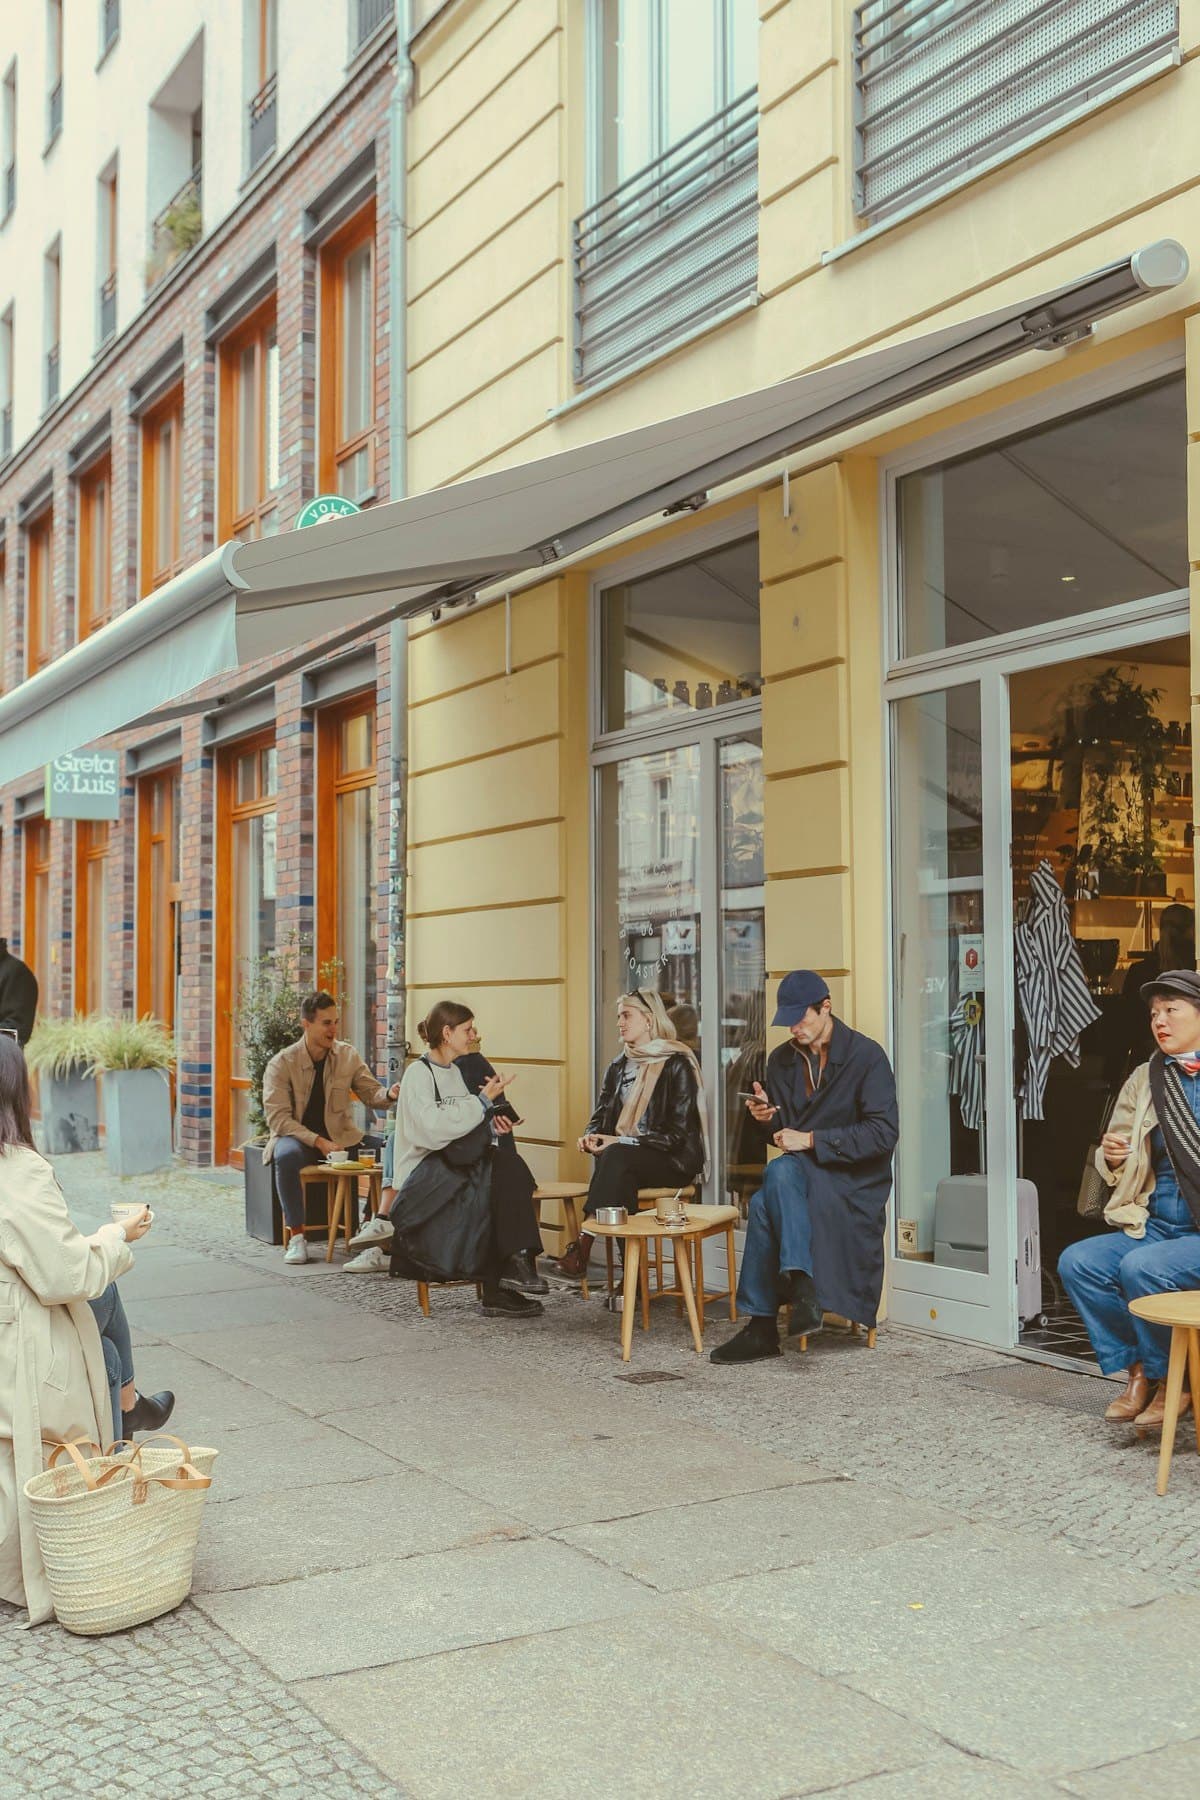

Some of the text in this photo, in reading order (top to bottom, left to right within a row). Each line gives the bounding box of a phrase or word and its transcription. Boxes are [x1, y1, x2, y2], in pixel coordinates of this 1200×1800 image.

[309, 502, 350, 519] VOLK
[53, 753, 116, 774] Greta
[71, 774, 116, 796] Luis
